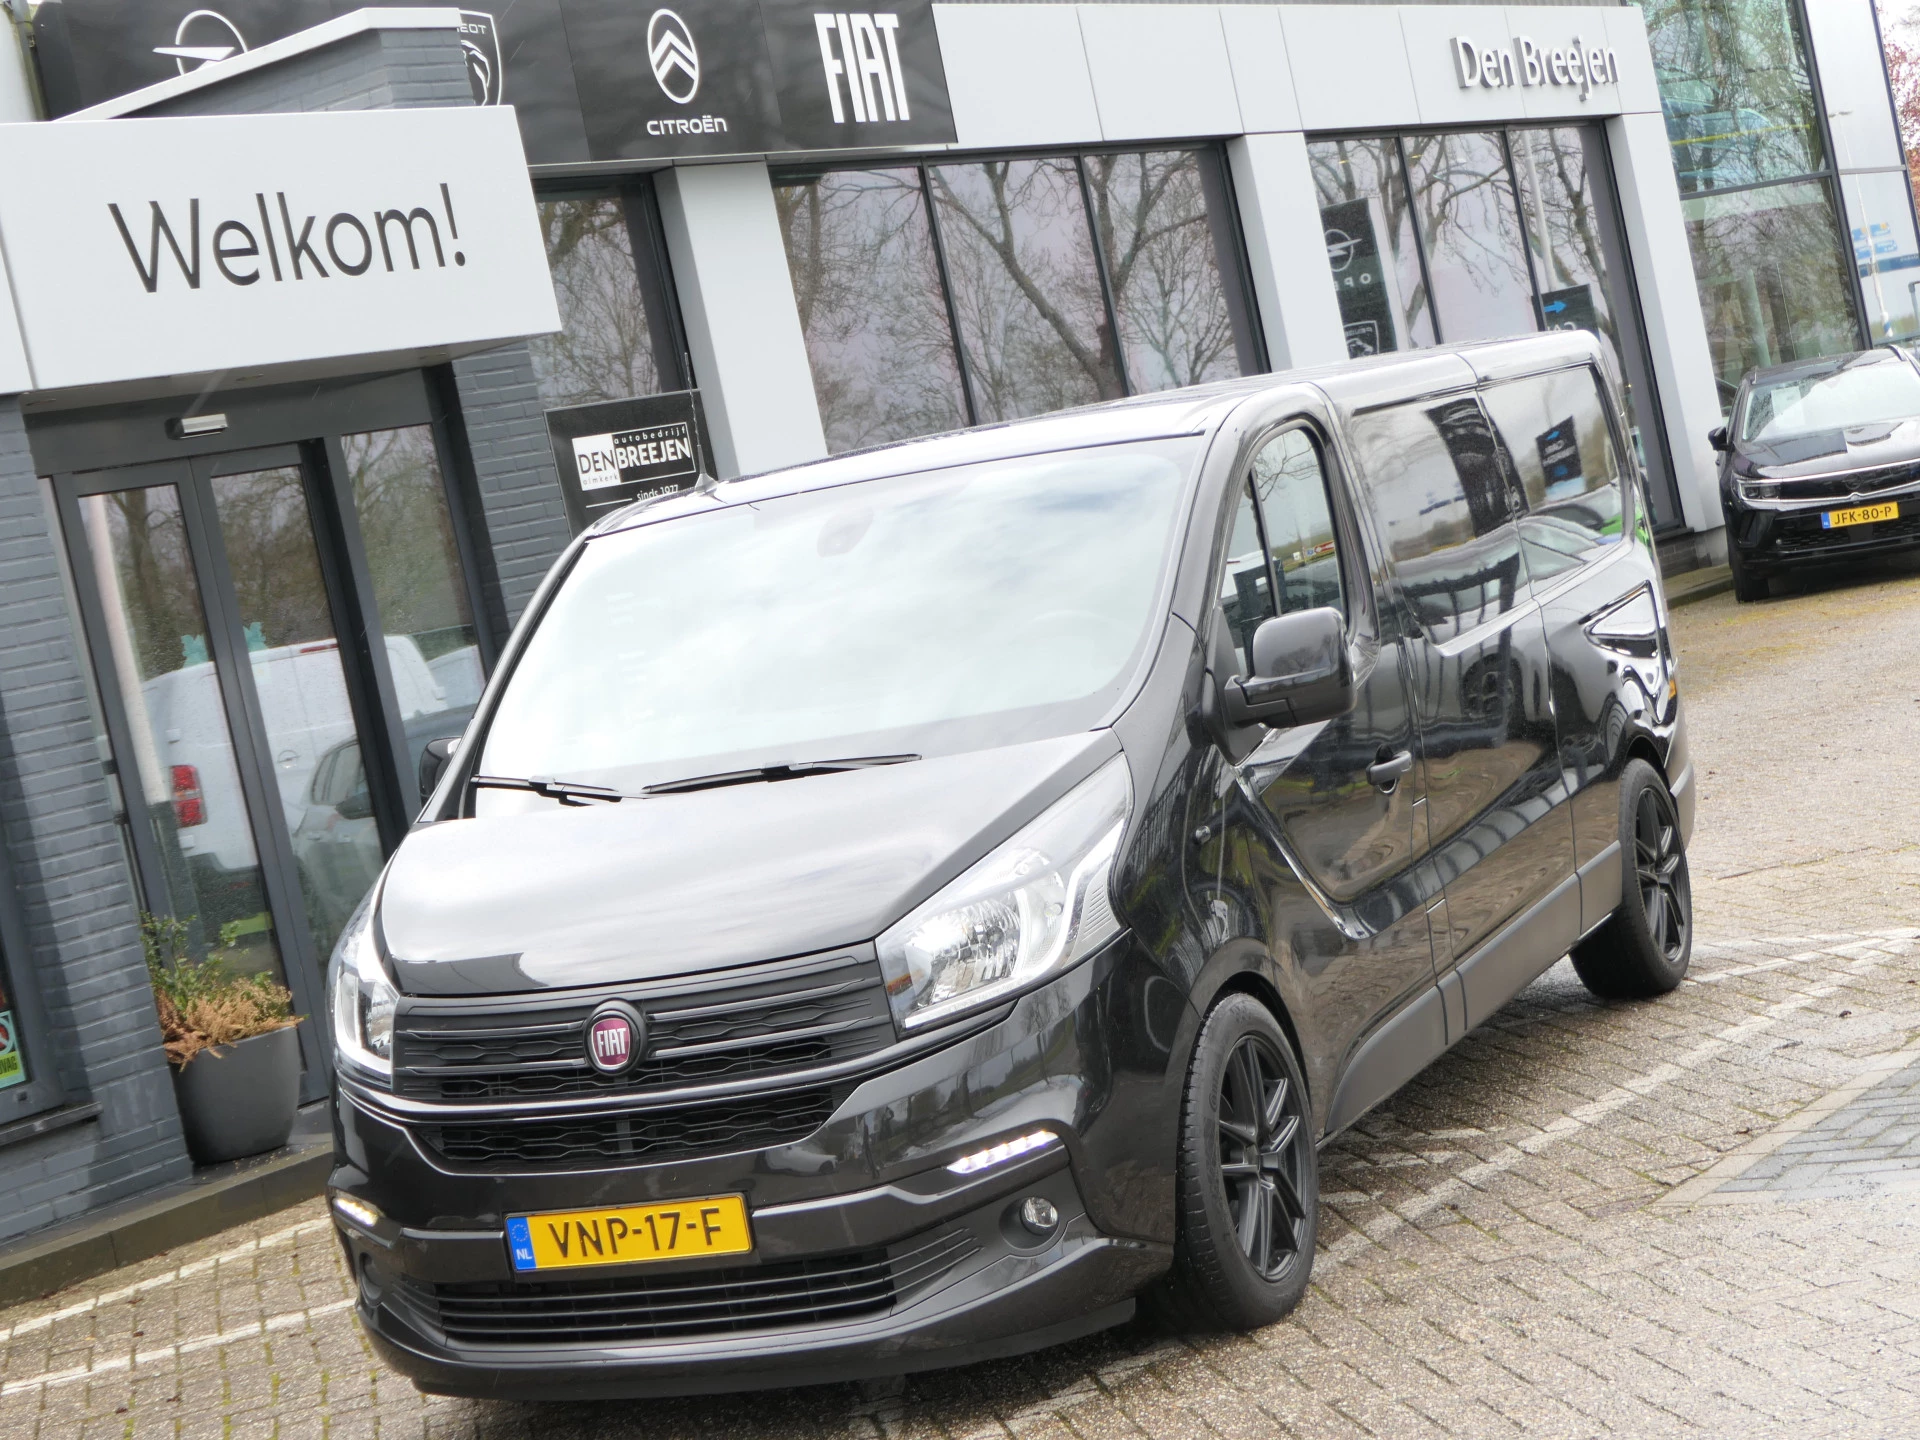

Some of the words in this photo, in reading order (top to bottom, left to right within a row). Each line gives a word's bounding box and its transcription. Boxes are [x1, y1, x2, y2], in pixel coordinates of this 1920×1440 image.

[457, 23, 487, 35] EOT
[813, 13, 910, 123] FIAT
[1450, 35, 1516, 88] Den
[1513, 34, 1620, 101] Breejen
[107, 182, 467, 293] Welkom!
[613, 425, 687, 445] autobedrijf
[577, 449, 616, 475] DEN
[615, 437, 691, 470] BREEJEN
[636, 488, 659, 502] sinds
[660, 484, 679, 496] 1977
[1834, 505, 1892, 525] JFK-80-P
[596, 1027, 627, 1057] FIAT
[515, 1248, 533, 1261] NL
[547, 1207, 722, 1259] VNP-17-F
